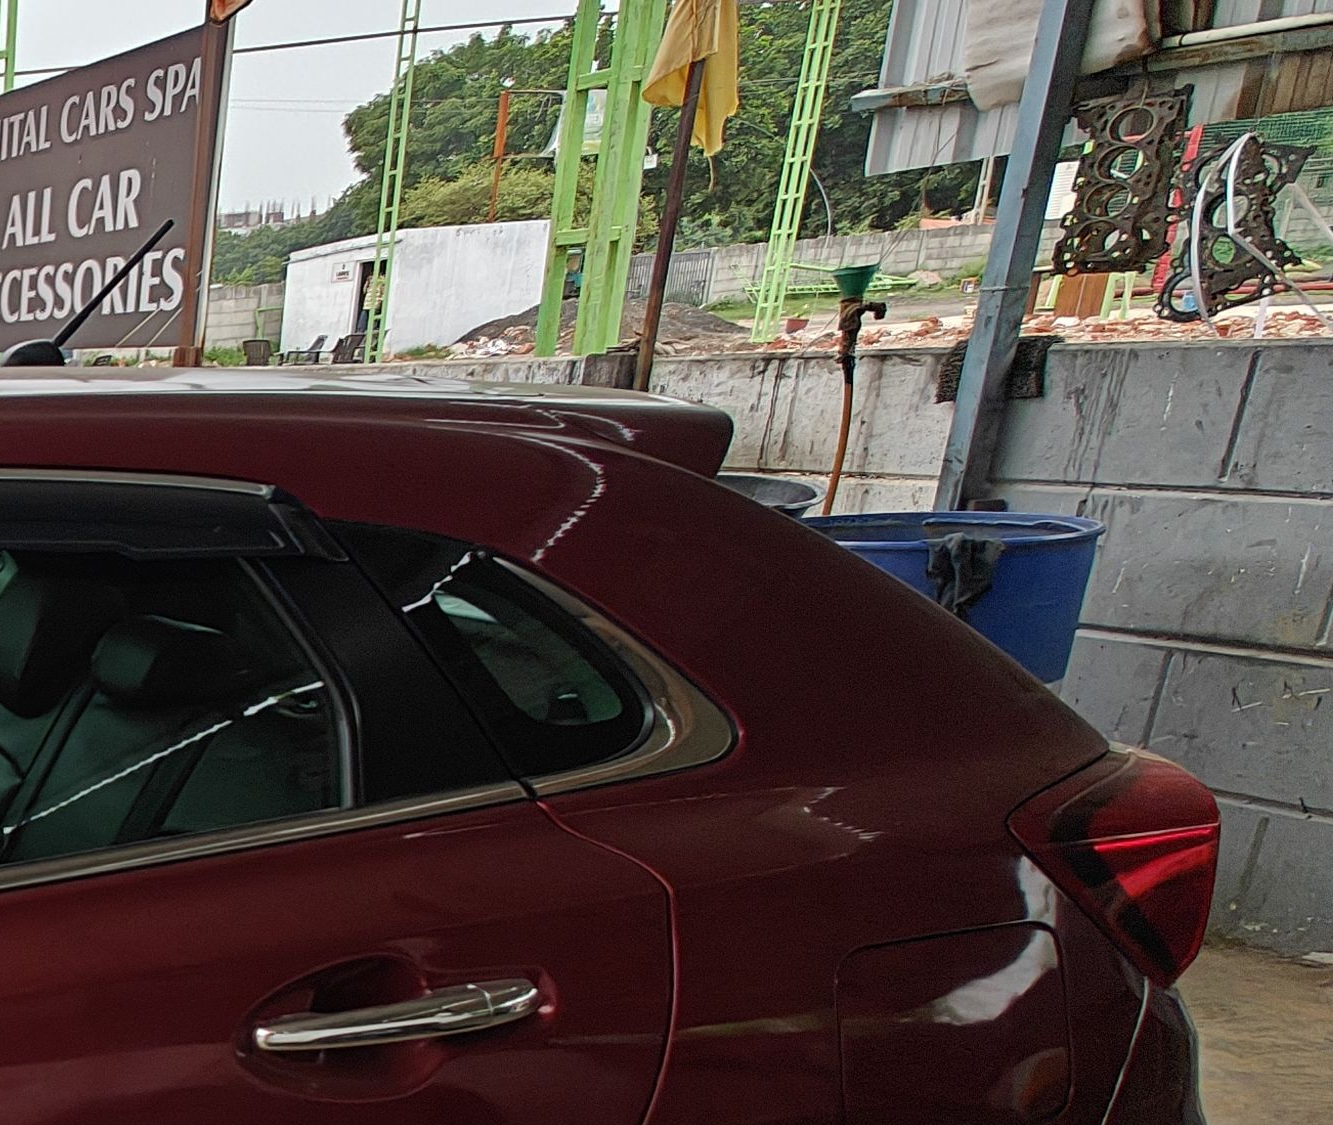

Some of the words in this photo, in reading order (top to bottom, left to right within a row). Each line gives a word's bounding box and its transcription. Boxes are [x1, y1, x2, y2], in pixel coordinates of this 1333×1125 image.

[60, 78, 136, 144] CARS
[143, 57, 202, 122] SPA
[1, 187, 56, 249] ALL
[67, 169, 141, 238] CAR
